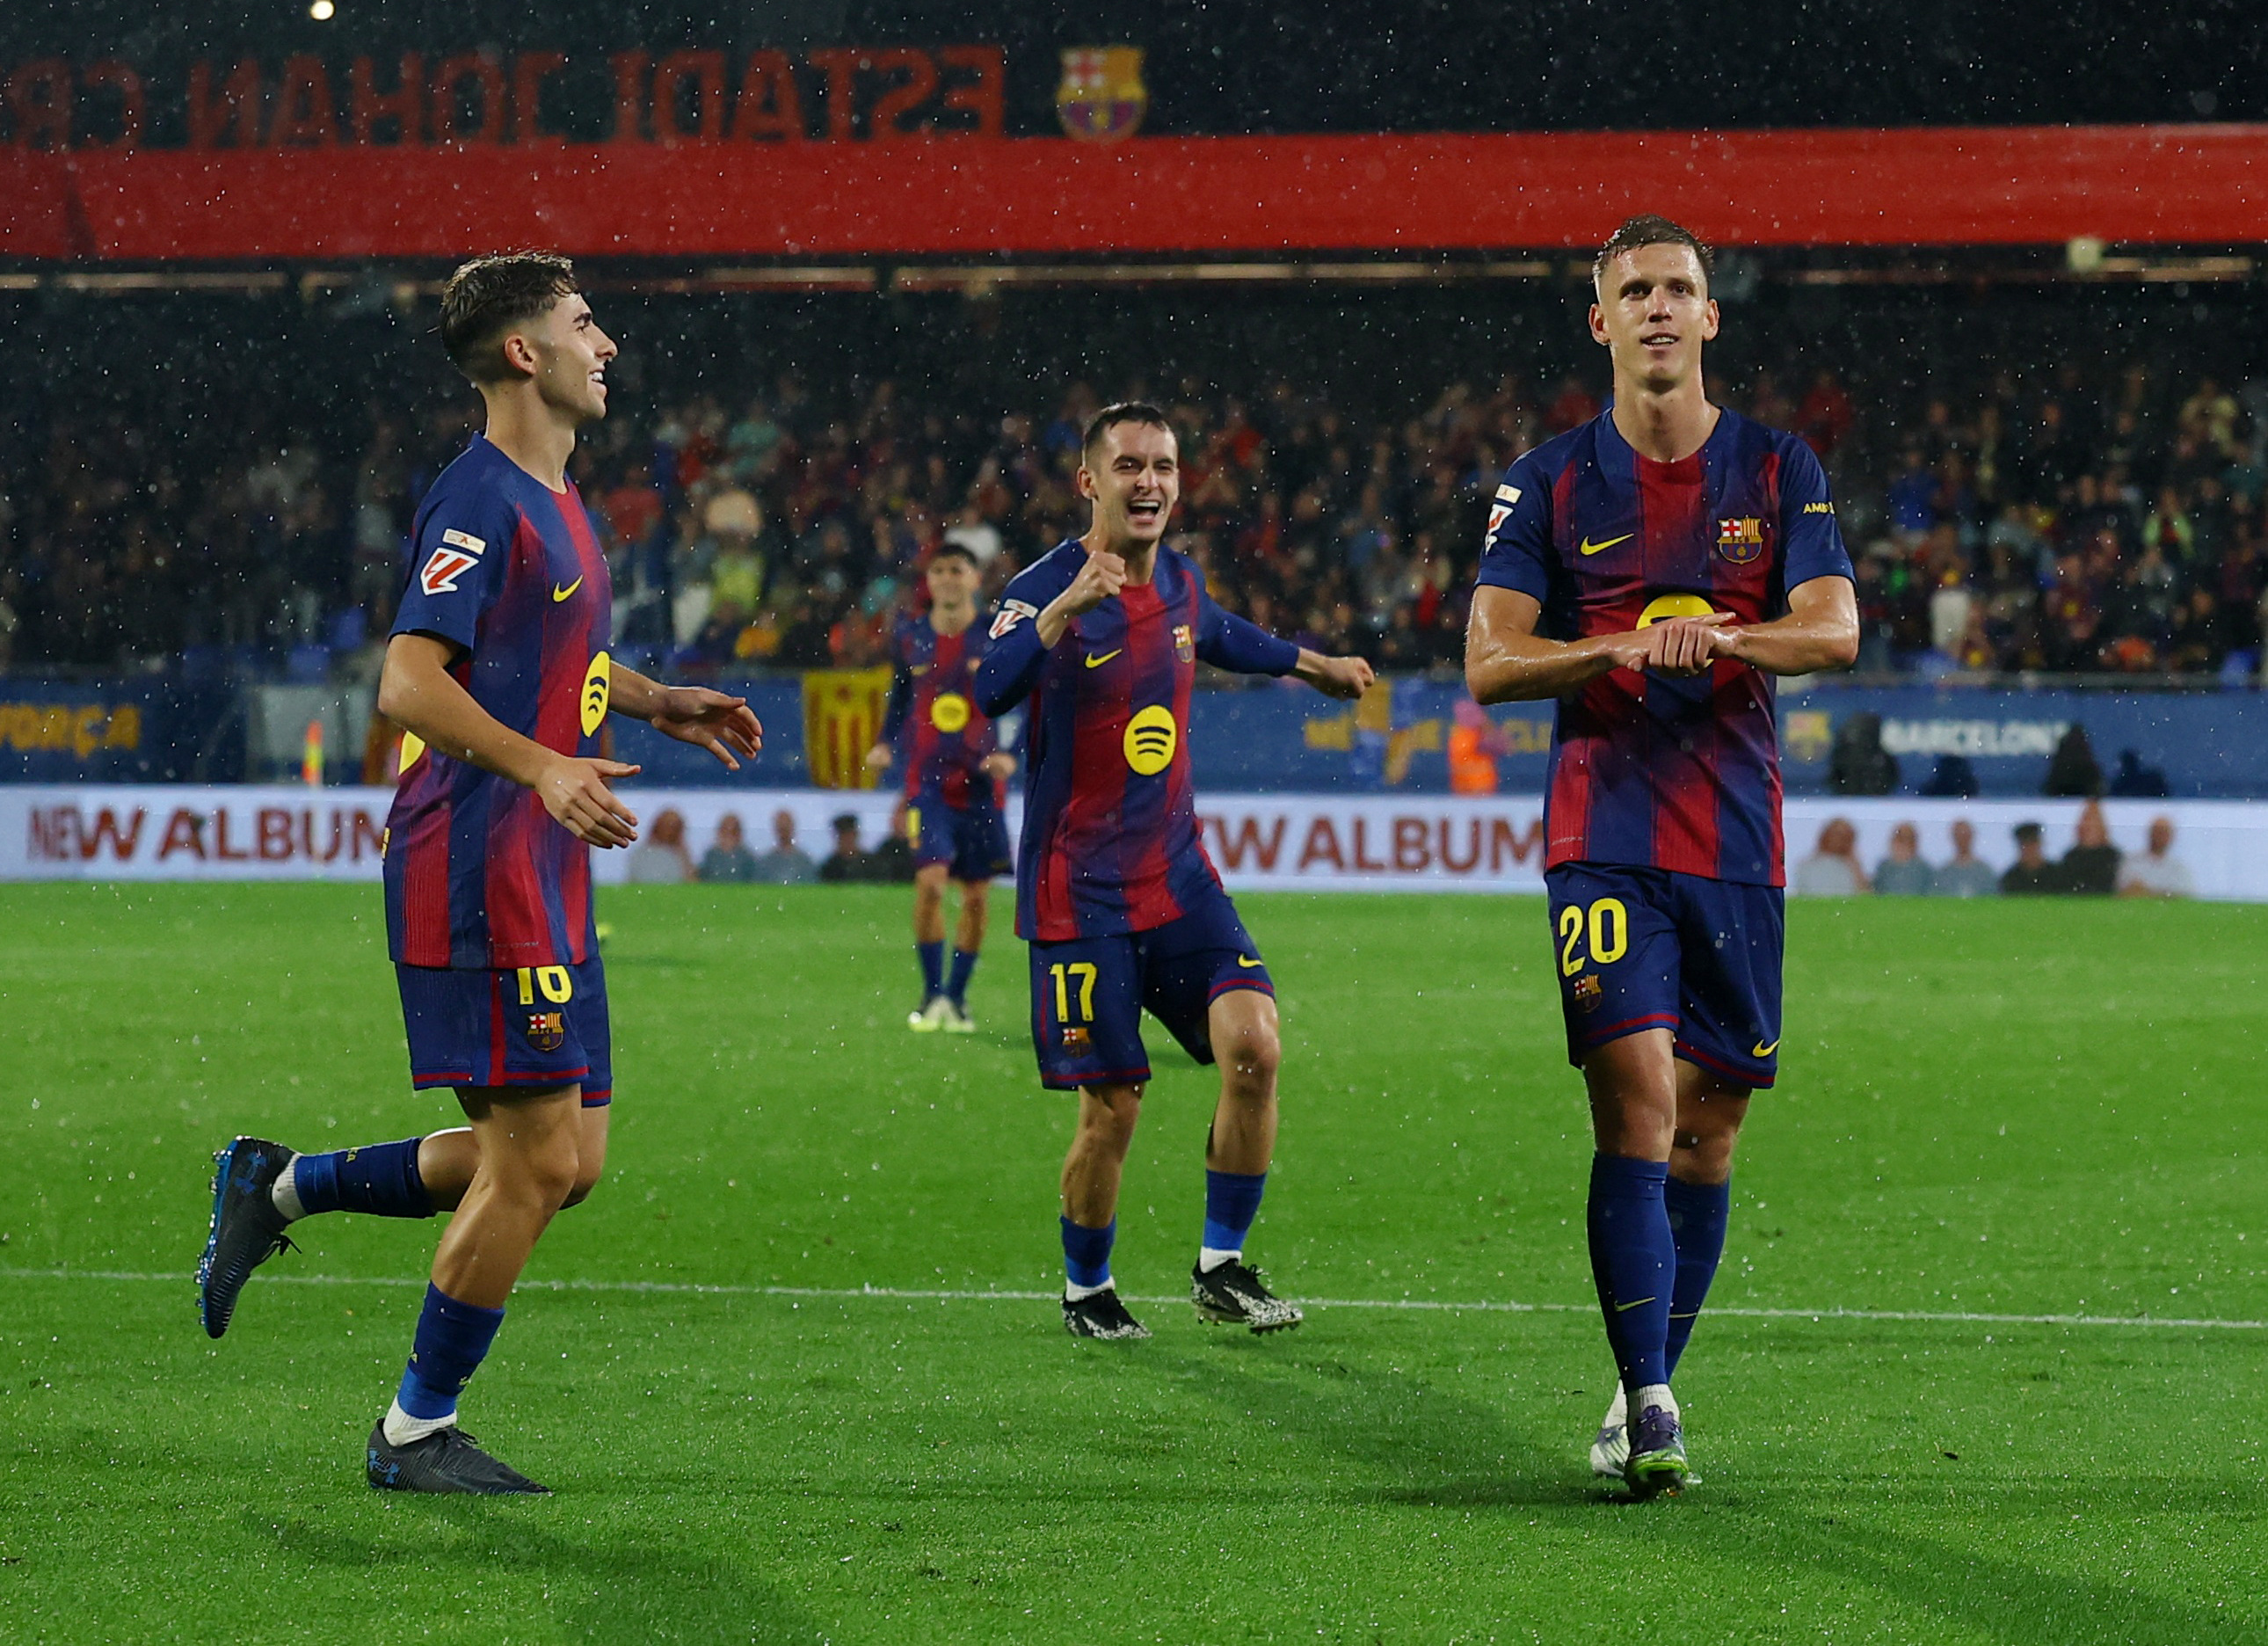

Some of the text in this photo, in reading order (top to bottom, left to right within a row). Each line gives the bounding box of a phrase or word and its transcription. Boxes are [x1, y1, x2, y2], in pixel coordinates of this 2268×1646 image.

[26, 805, 147, 863] NEW
[1299, 815, 1545, 873] ALBUM
[1559, 898, 1627, 978] 20
[1050, 963, 1098, 1023] 17
